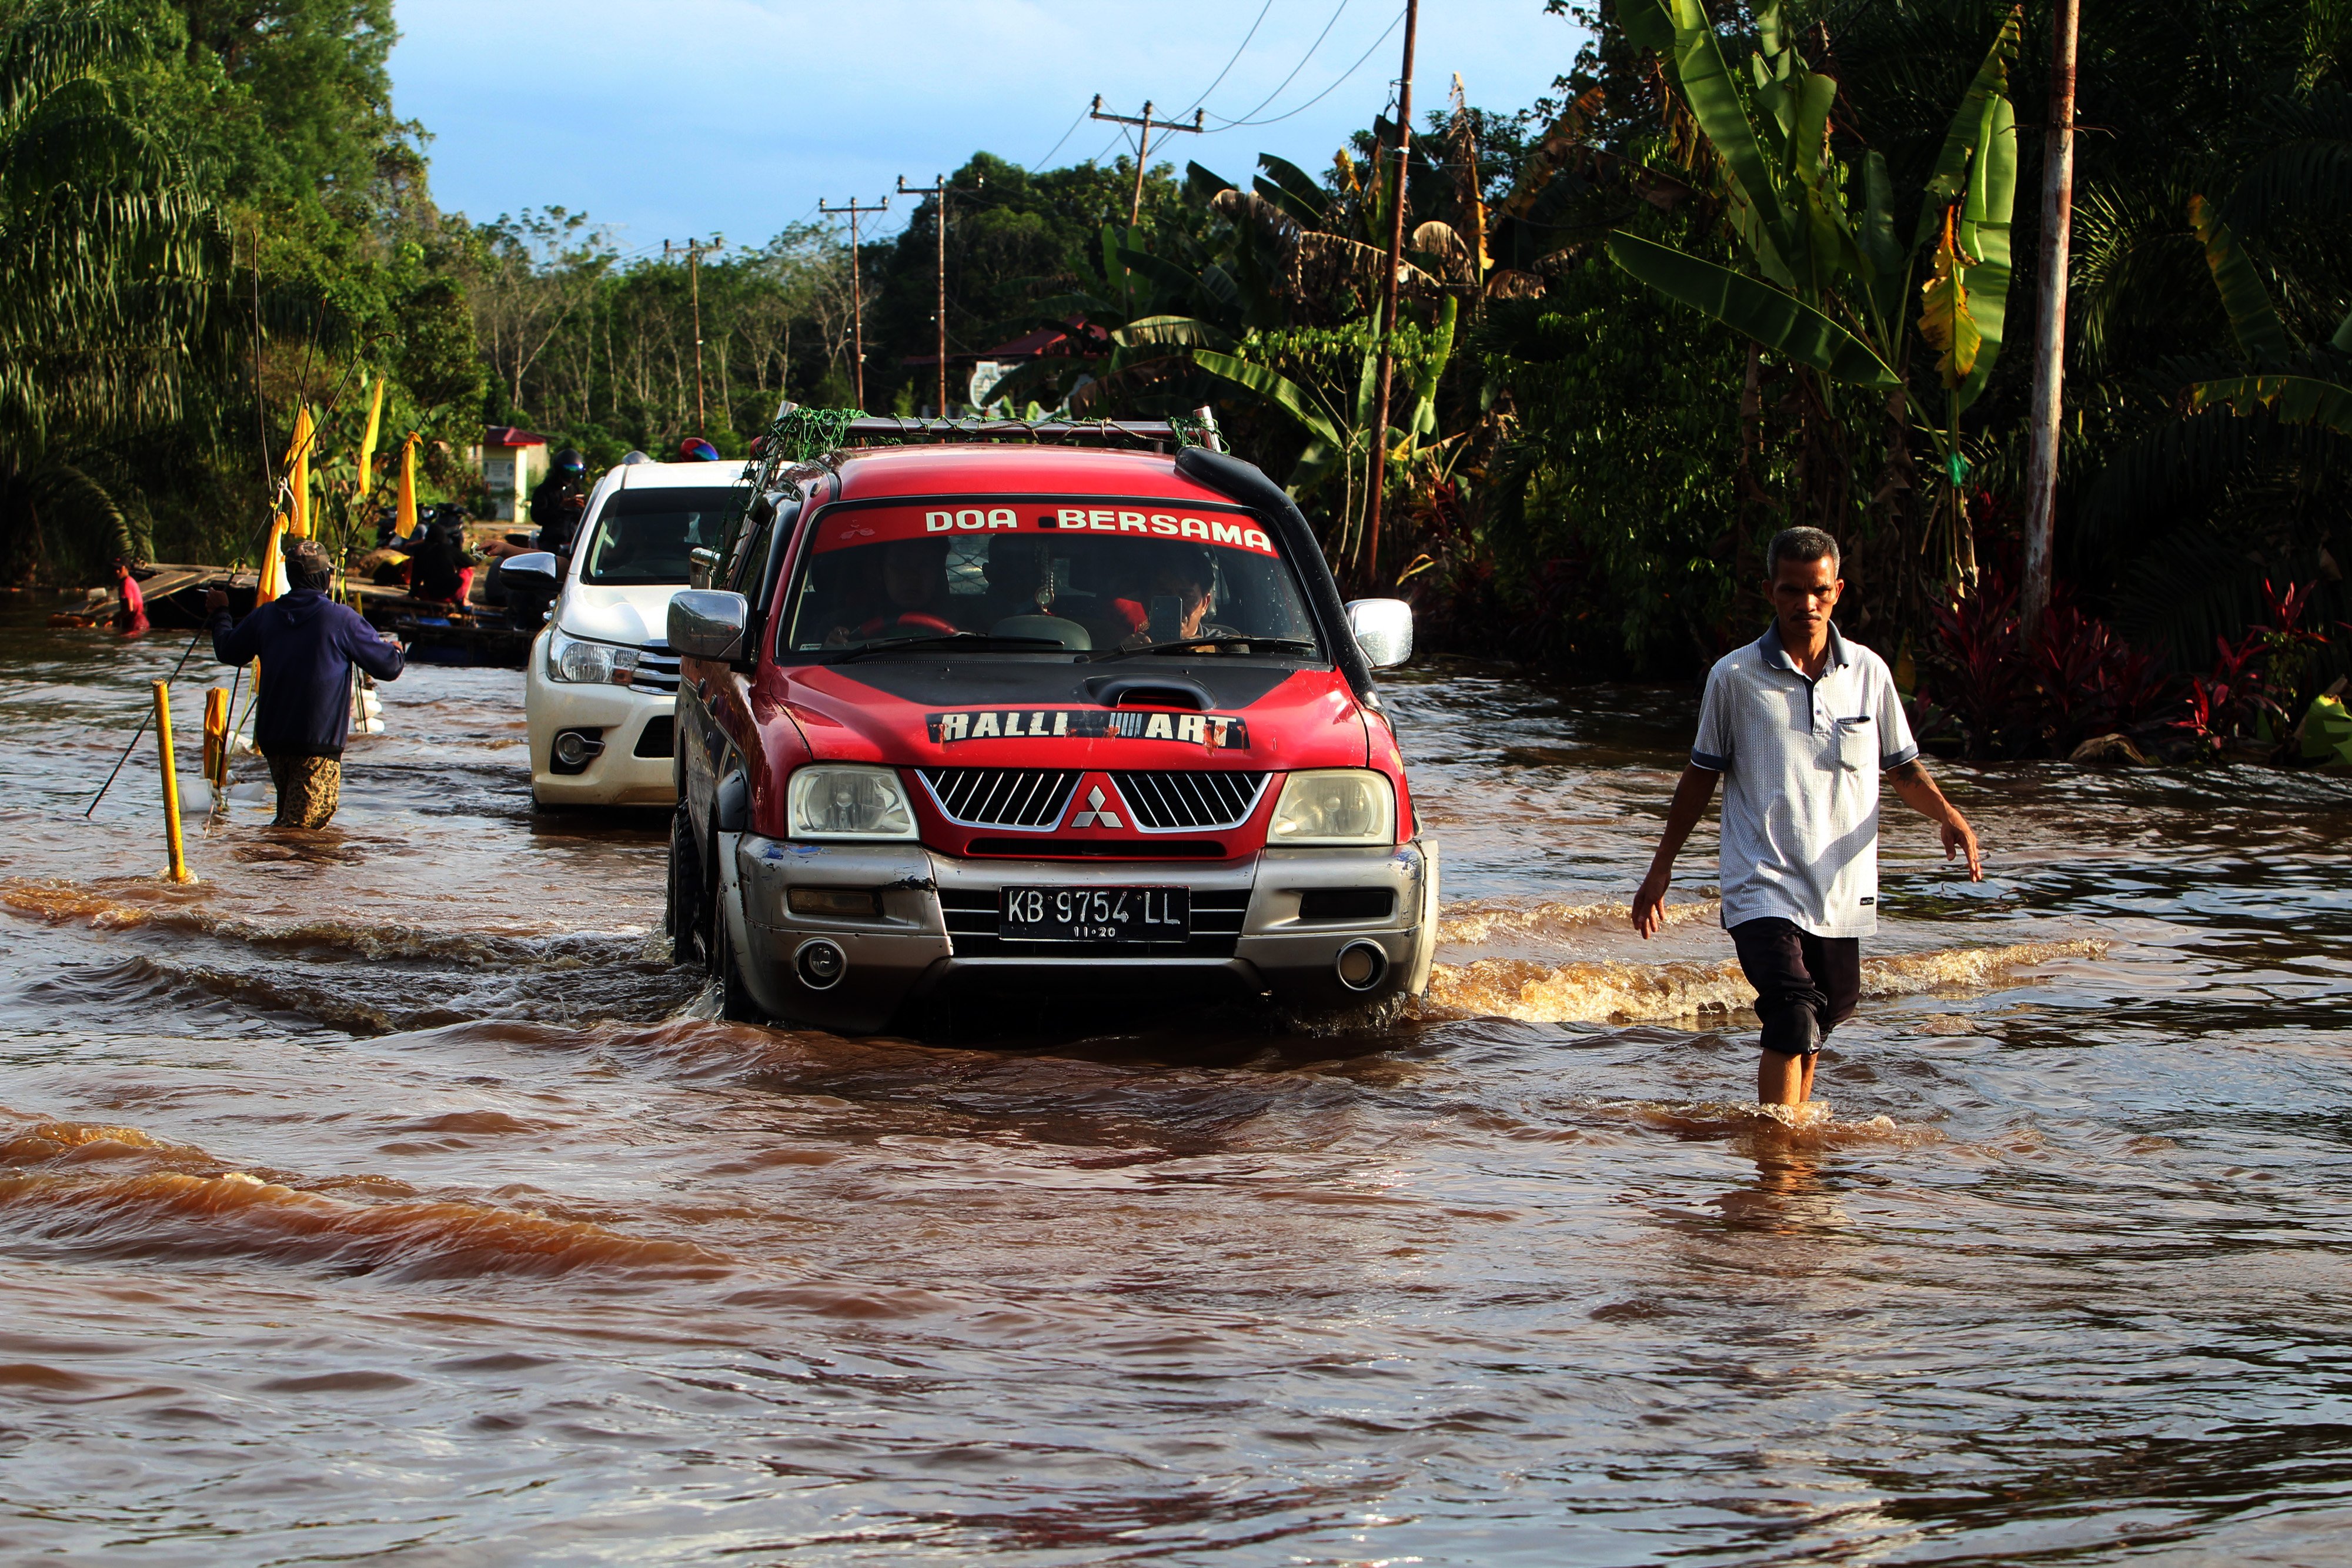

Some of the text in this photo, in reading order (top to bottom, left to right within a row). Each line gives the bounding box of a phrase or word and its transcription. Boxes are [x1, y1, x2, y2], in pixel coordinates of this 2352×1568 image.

[926, 509, 1272, 553] DOA BERSAMA
[1145, 713, 1237, 747] ART
[1008, 891, 1180, 925] KB 9754 LL
